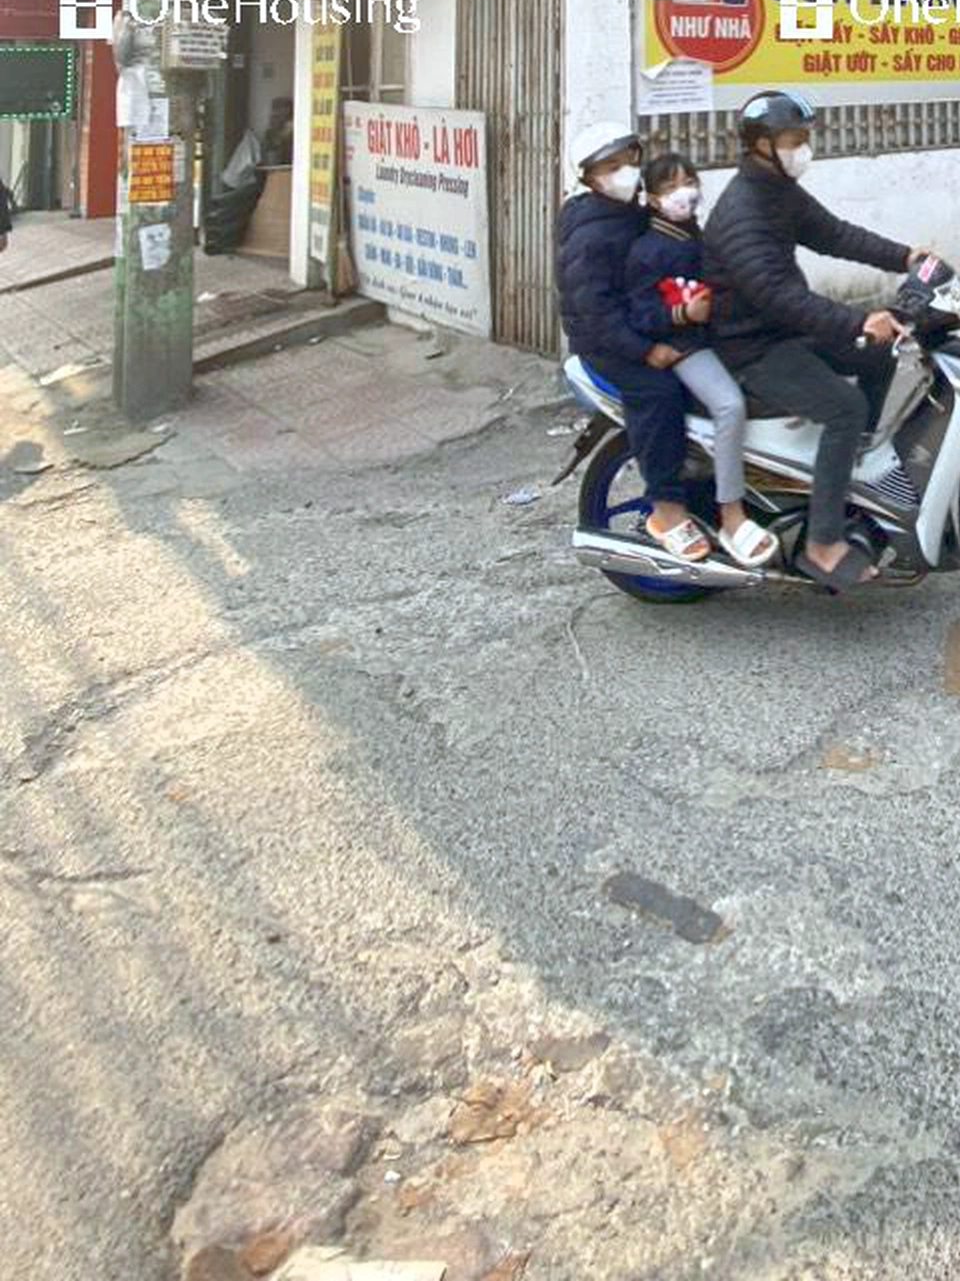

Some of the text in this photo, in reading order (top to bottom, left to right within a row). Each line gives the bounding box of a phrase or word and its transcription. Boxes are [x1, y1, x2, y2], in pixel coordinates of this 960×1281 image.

[671, 14, 711, 39] NHƯ
[803, 51, 842, 77] GIẶT
[892, 48, 922, 72] SẤY
[926, 53, 956, 72] CHO
[367, 113, 480, 169] GIẶT KHÔ LÀ HƠI
